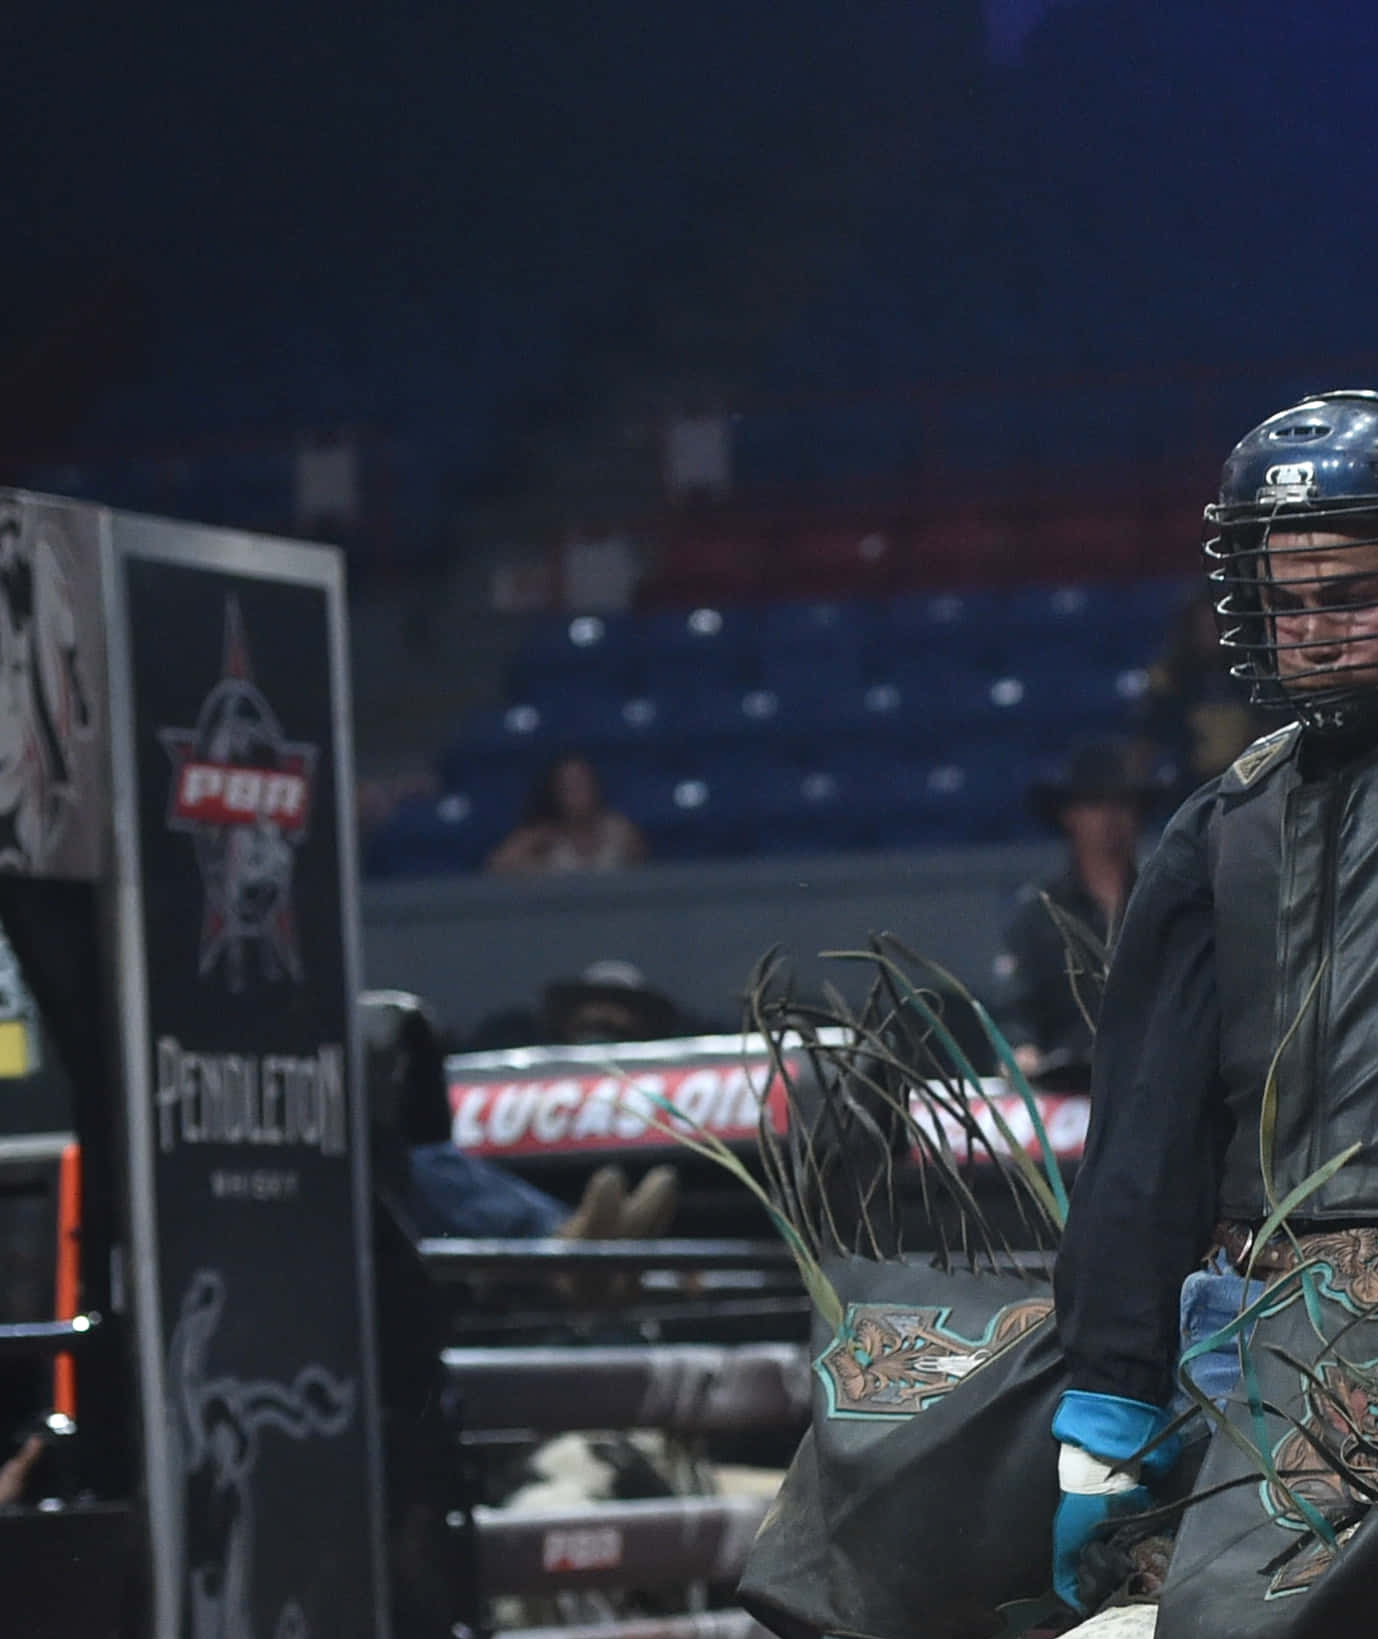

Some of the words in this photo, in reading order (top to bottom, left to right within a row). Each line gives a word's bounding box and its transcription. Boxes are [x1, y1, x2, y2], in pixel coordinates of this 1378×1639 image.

[156, 1033, 346, 1157] PENDLETON
[451, 1076, 665, 1147] LUCAS
[670, 1062, 770, 1134] OIL
